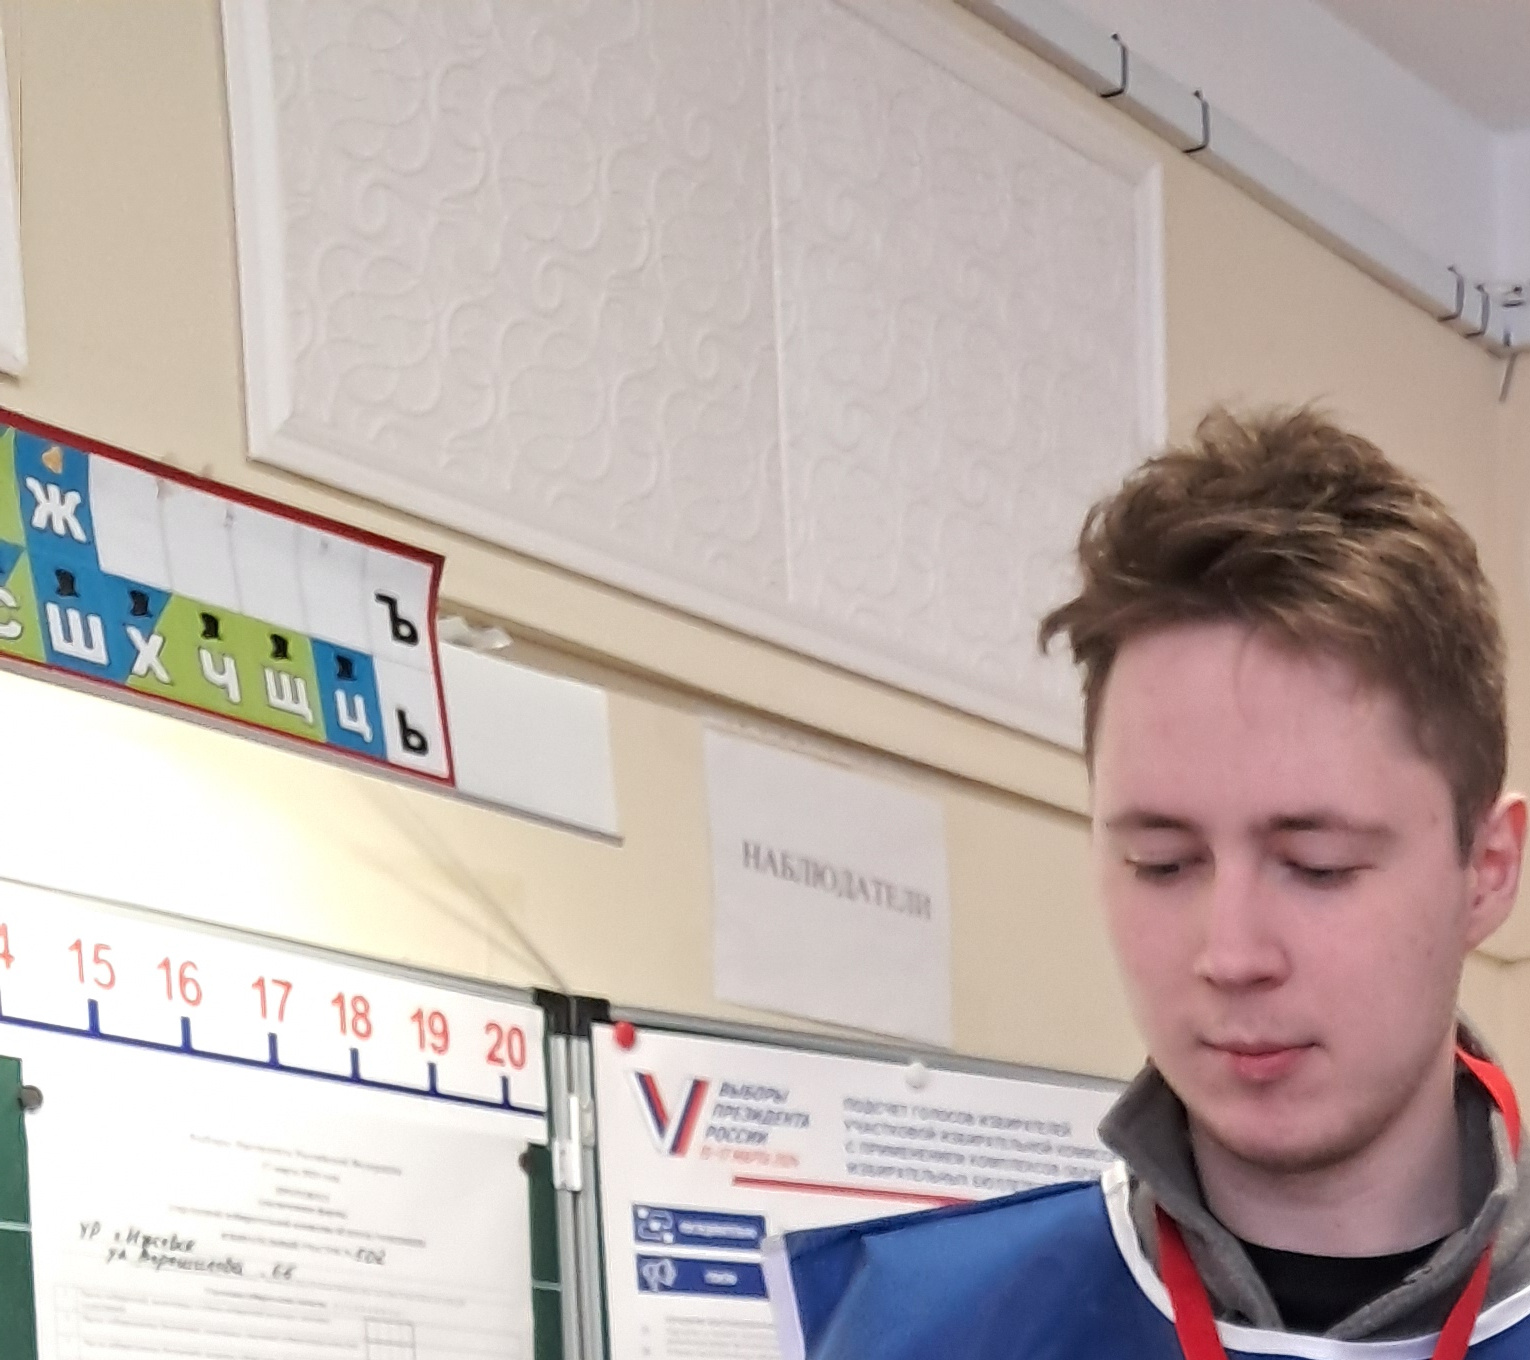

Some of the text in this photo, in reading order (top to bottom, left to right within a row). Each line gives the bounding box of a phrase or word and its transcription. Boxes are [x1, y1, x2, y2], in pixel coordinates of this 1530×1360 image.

[26, 476, 87, 542] Ж
[741, 838, 931, 921] НАБЛЮДАТЕЛИ
[68, 938, 117, 990] 15
[157, 956, 203, 1006] 16
[251, 976, 293, 1022] 17
[331, 992, 373, 1040] 18
[410, 1007, 450, 1055] 19
[483, 1021, 528, 1070] 20
[718, 1081, 790, 1104] ВЫБОРЫ
[705, 1125, 769, 1145] РОССИИ
